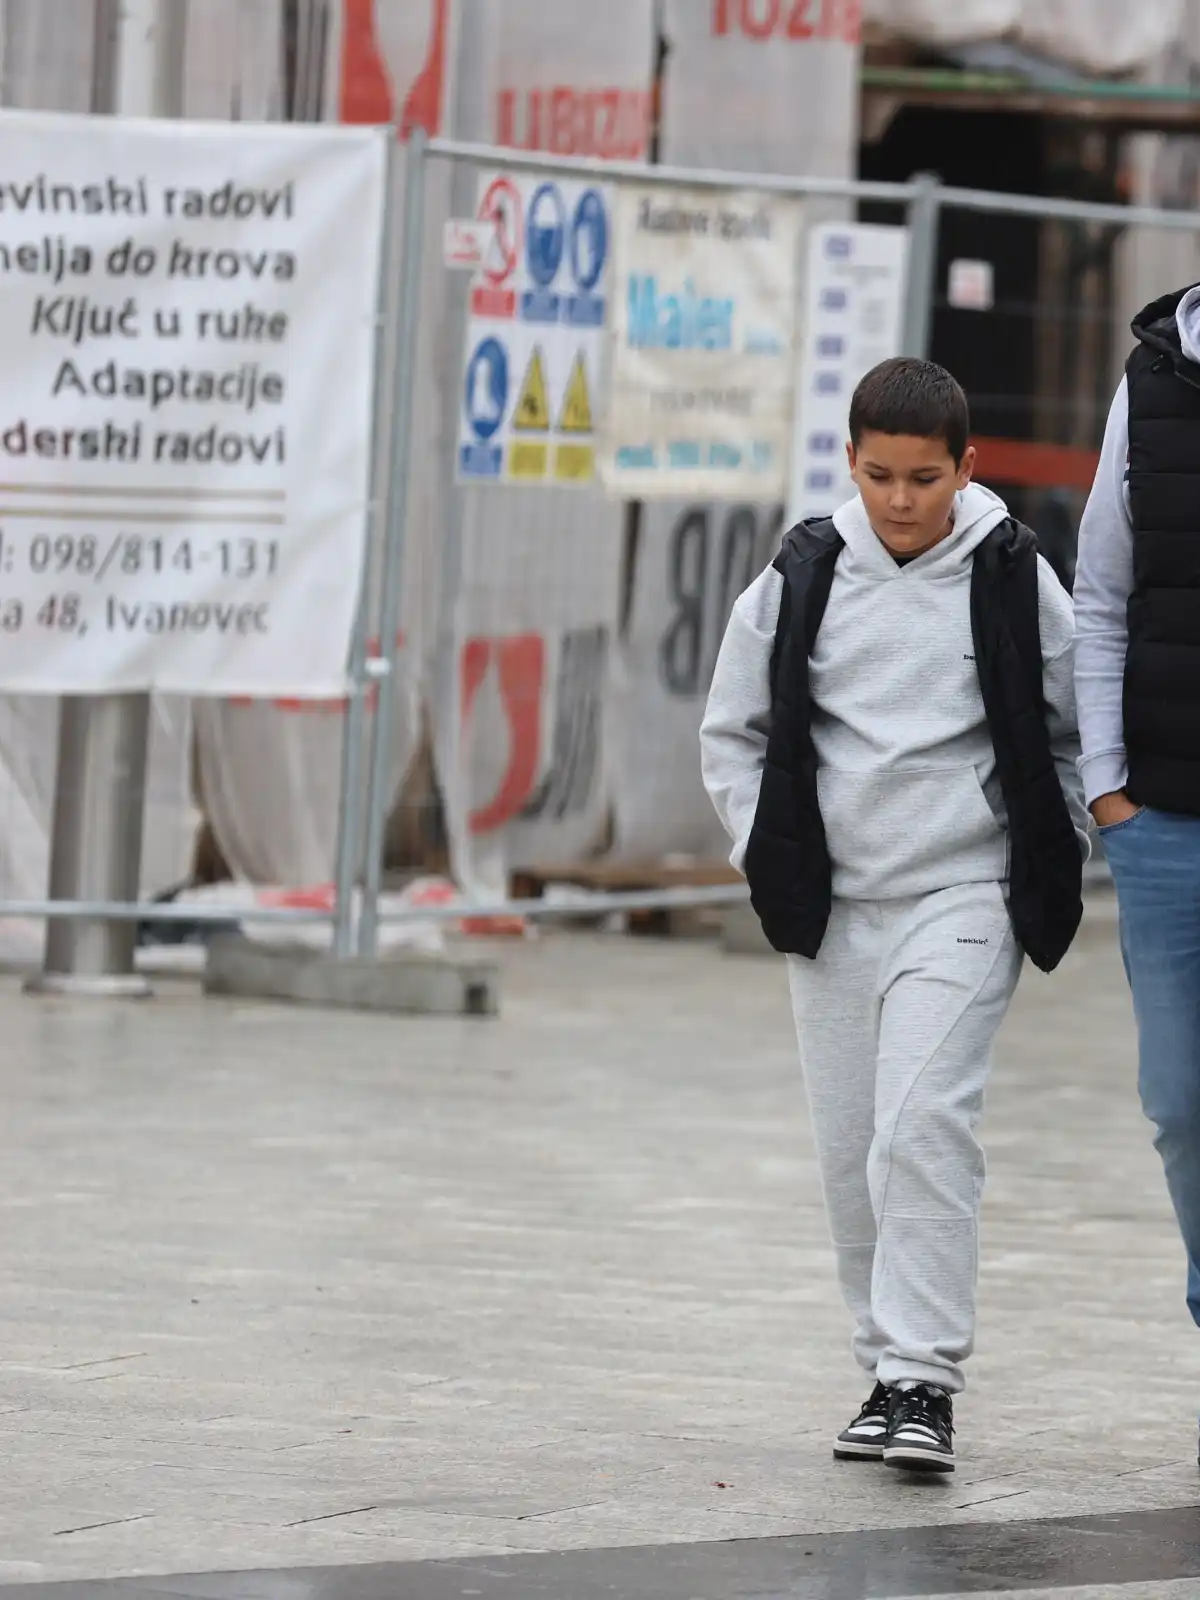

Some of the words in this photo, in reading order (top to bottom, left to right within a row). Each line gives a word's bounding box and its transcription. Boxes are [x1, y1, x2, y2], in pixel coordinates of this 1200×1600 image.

[163, 180, 294, 221] radovi
[105, 238, 156, 278] do
[167, 240, 297, 281] krova
[31, 295, 140, 346] Ključ
[154, 308, 180, 338] u
[198, 303, 290, 341] ruke
[52, 357, 285, 413] Adaptacije
[153, 424, 286, 466] radovi
[28, 533, 279, 583] 098/814-131
